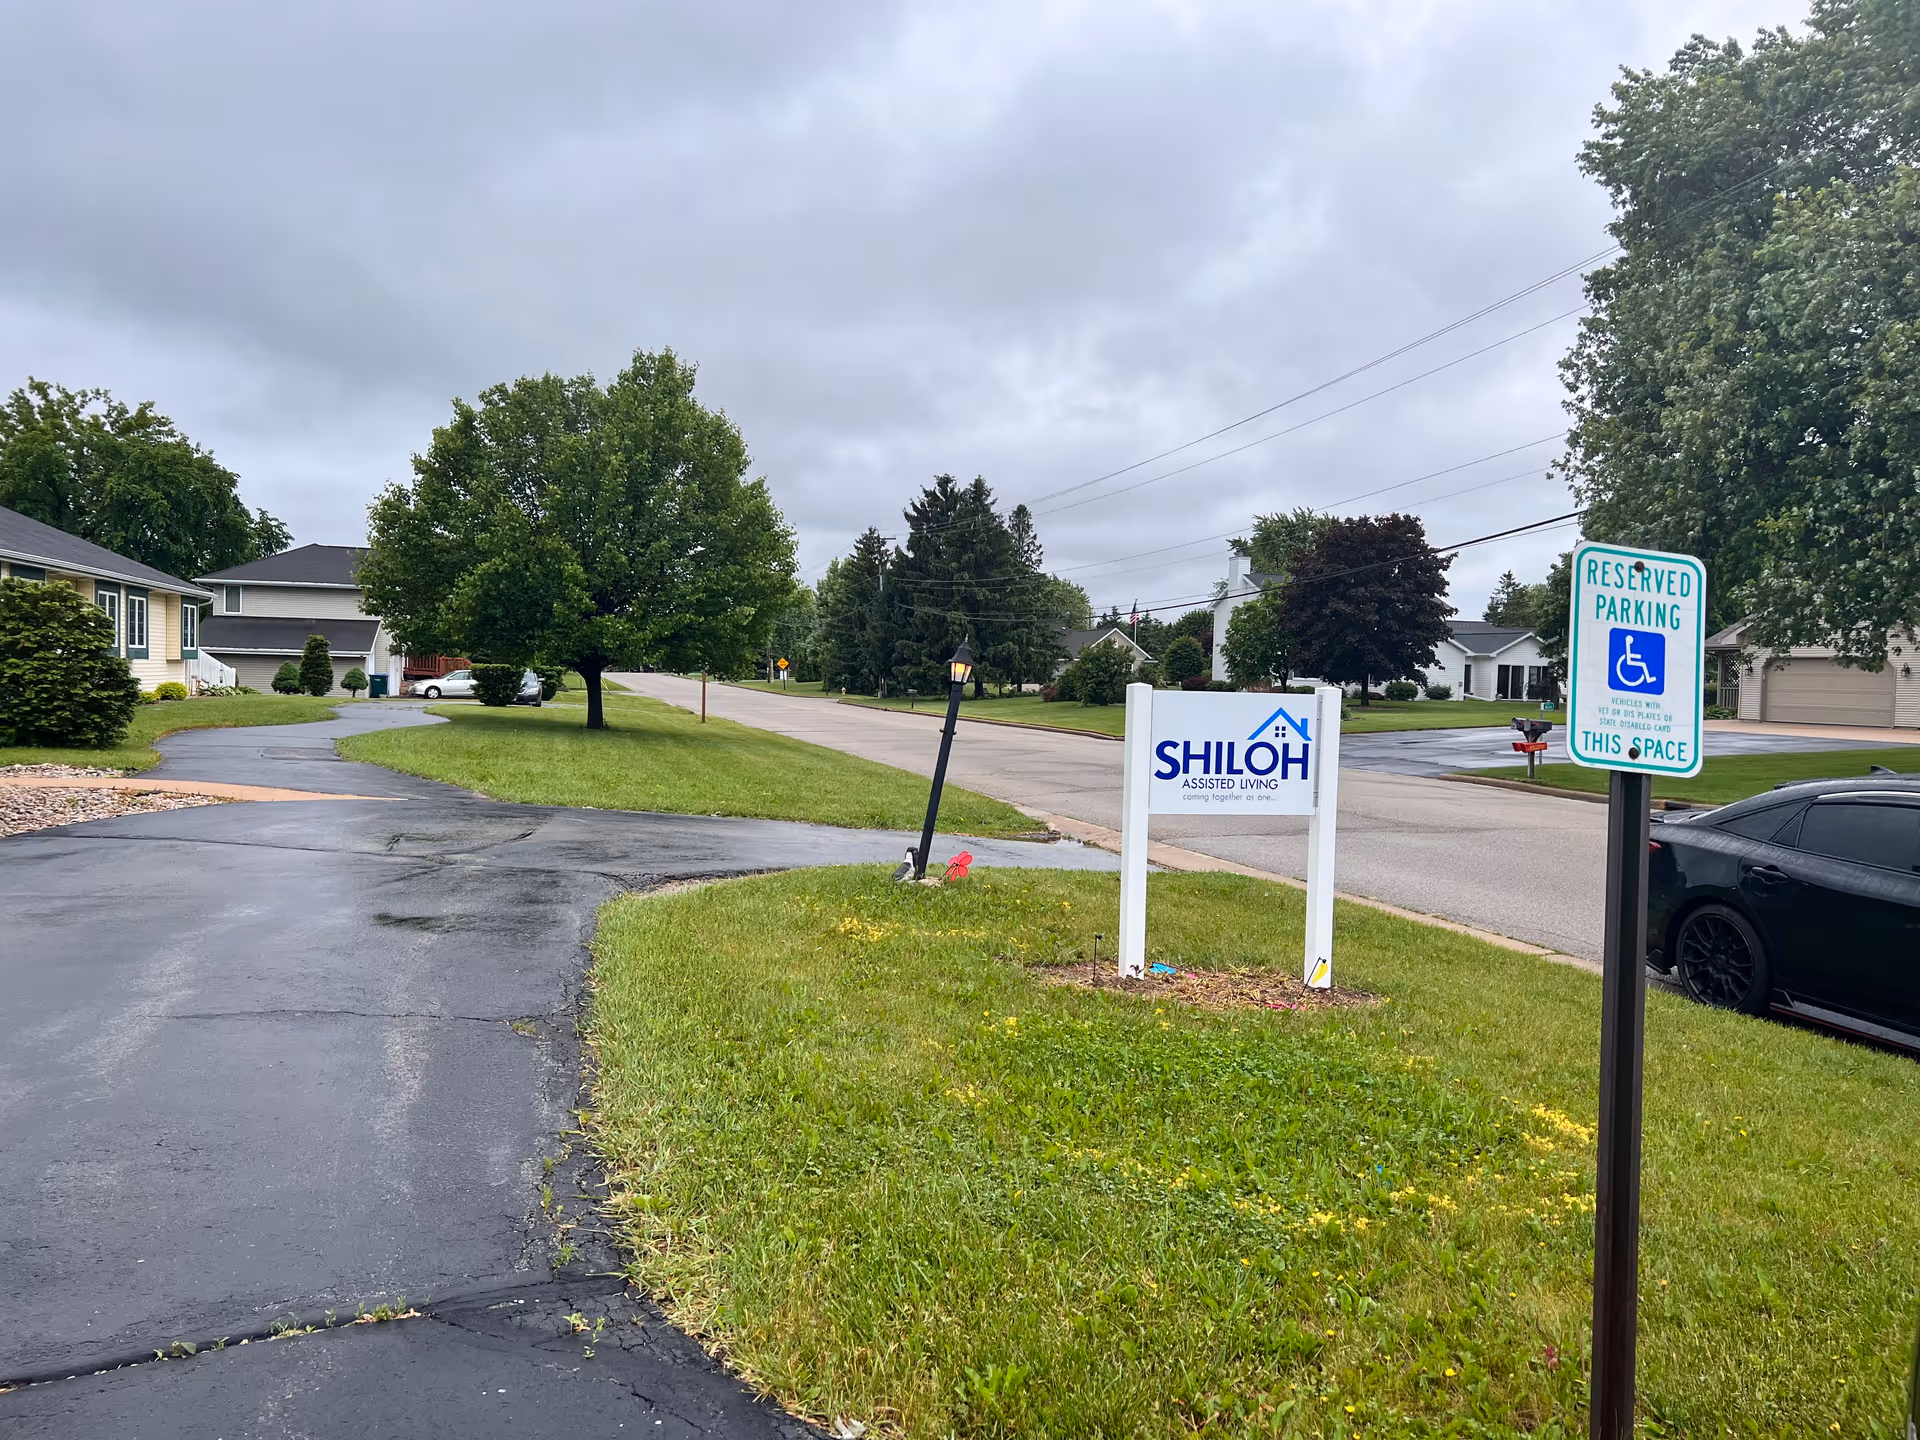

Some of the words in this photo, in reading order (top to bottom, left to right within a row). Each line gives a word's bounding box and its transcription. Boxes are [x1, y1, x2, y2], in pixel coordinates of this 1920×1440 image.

[1587, 559, 1691, 598] RESERVED
[1595, 594, 1681, 631] PARKING
[1611, 697, 1642, 708] VEHICLES
[1645, 701, 1660, 710] WITH
[1597, 706, 1609, 715] VET
[1611, 708, 1620, 716] OR
[1624, 709, 1635, 718] DIS
[1638, 711, 1660, 721] PLATES
[1664, 714, 1672, 722] OR
[1599, 718, 1616, 727] STATE
[1620, 720, 1651, 731] DISABLED
[1654, 724, 1671, 733] CARD
[1582, 730, 1621, 755] THIS
[1632, 736, 1687, 762] SPACE
[1154, 739, 1310, 780] SHILOH
[1182, 777, 1235, 790] ASSISTED
[1240, 778, 1279, 790] LIVING
[1182, 793, 1209, 802] coming
[1212, 792, 1243, 803] together
